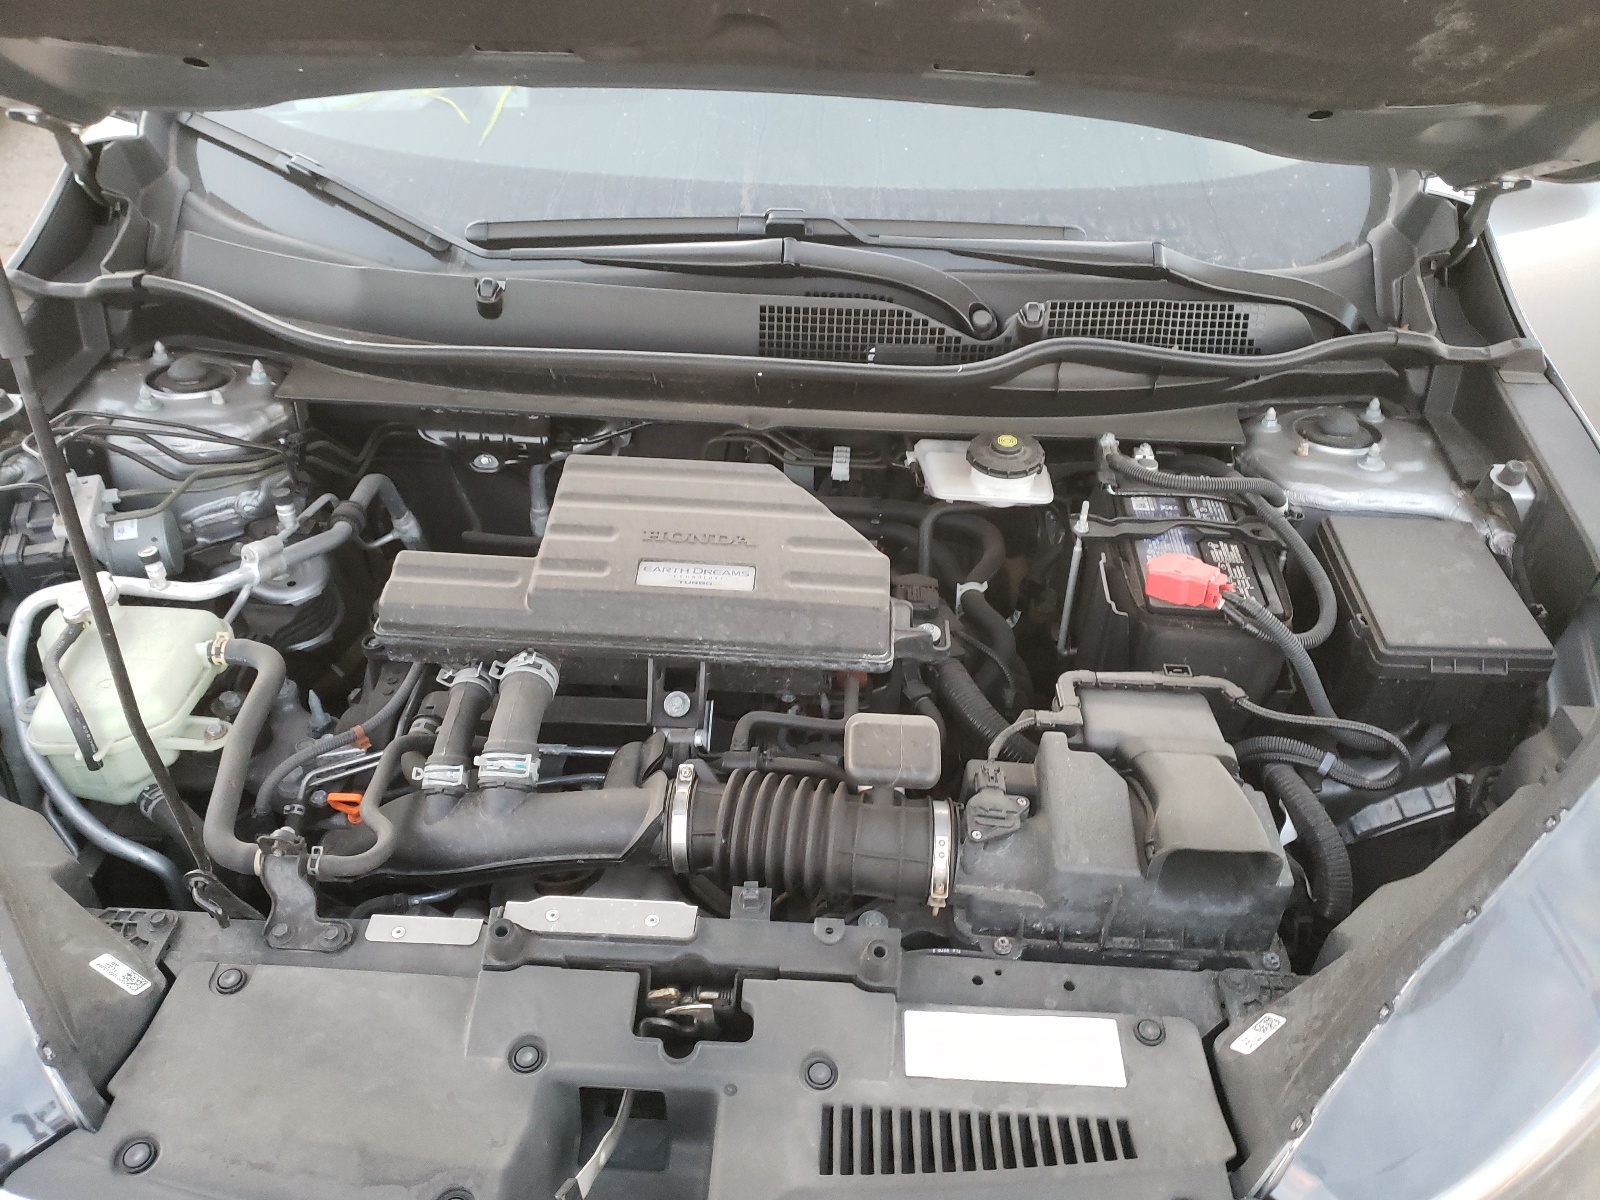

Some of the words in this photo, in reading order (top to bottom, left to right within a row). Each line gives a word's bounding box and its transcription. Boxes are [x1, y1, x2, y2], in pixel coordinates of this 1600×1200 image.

[642, 530, 757, 548] HONDA
[643, 565, 690, 574] EARTH
[692, 566, 750, 577] DREAMS
